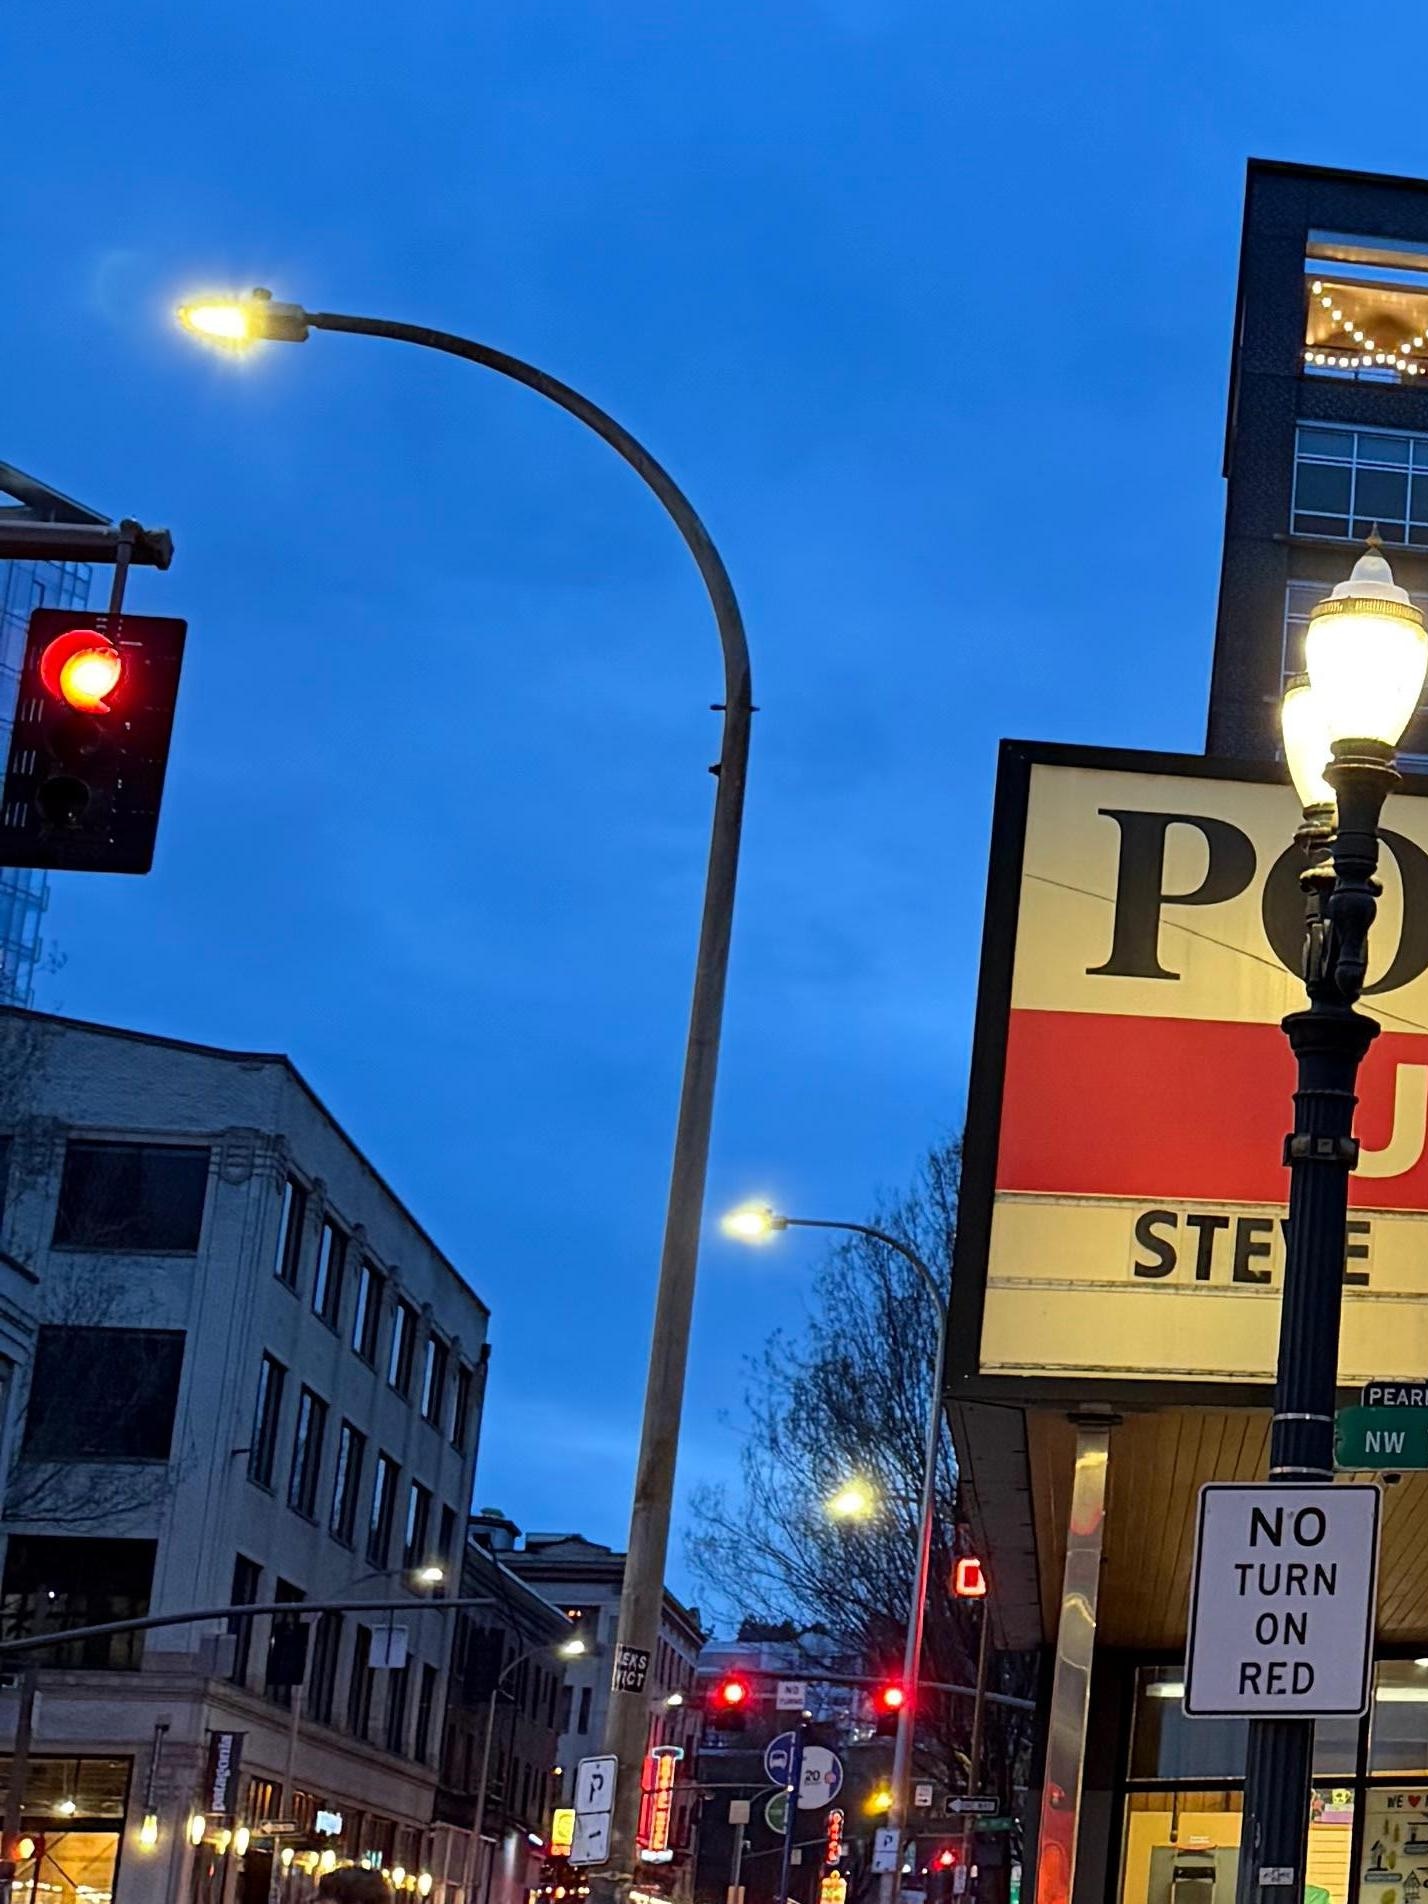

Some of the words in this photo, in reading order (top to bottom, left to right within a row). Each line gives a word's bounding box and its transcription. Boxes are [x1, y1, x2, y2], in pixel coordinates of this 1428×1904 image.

[1134, 1209, 1371, 1286] STEE
[1365, 1430, 1405, 1453] NW
[1249, 1507, 1326, 1547] NO
[1234, 1563, 1337, 1595] TURN
[1255, 1612, 1307, 1645] ON
[1239, 1662, 1314, 1695] RED
[211, 1735, 233, 1811] patagonia
[805, 1769, 821, 1781] 20
[1387, 1796, 1403, 1808] WE
